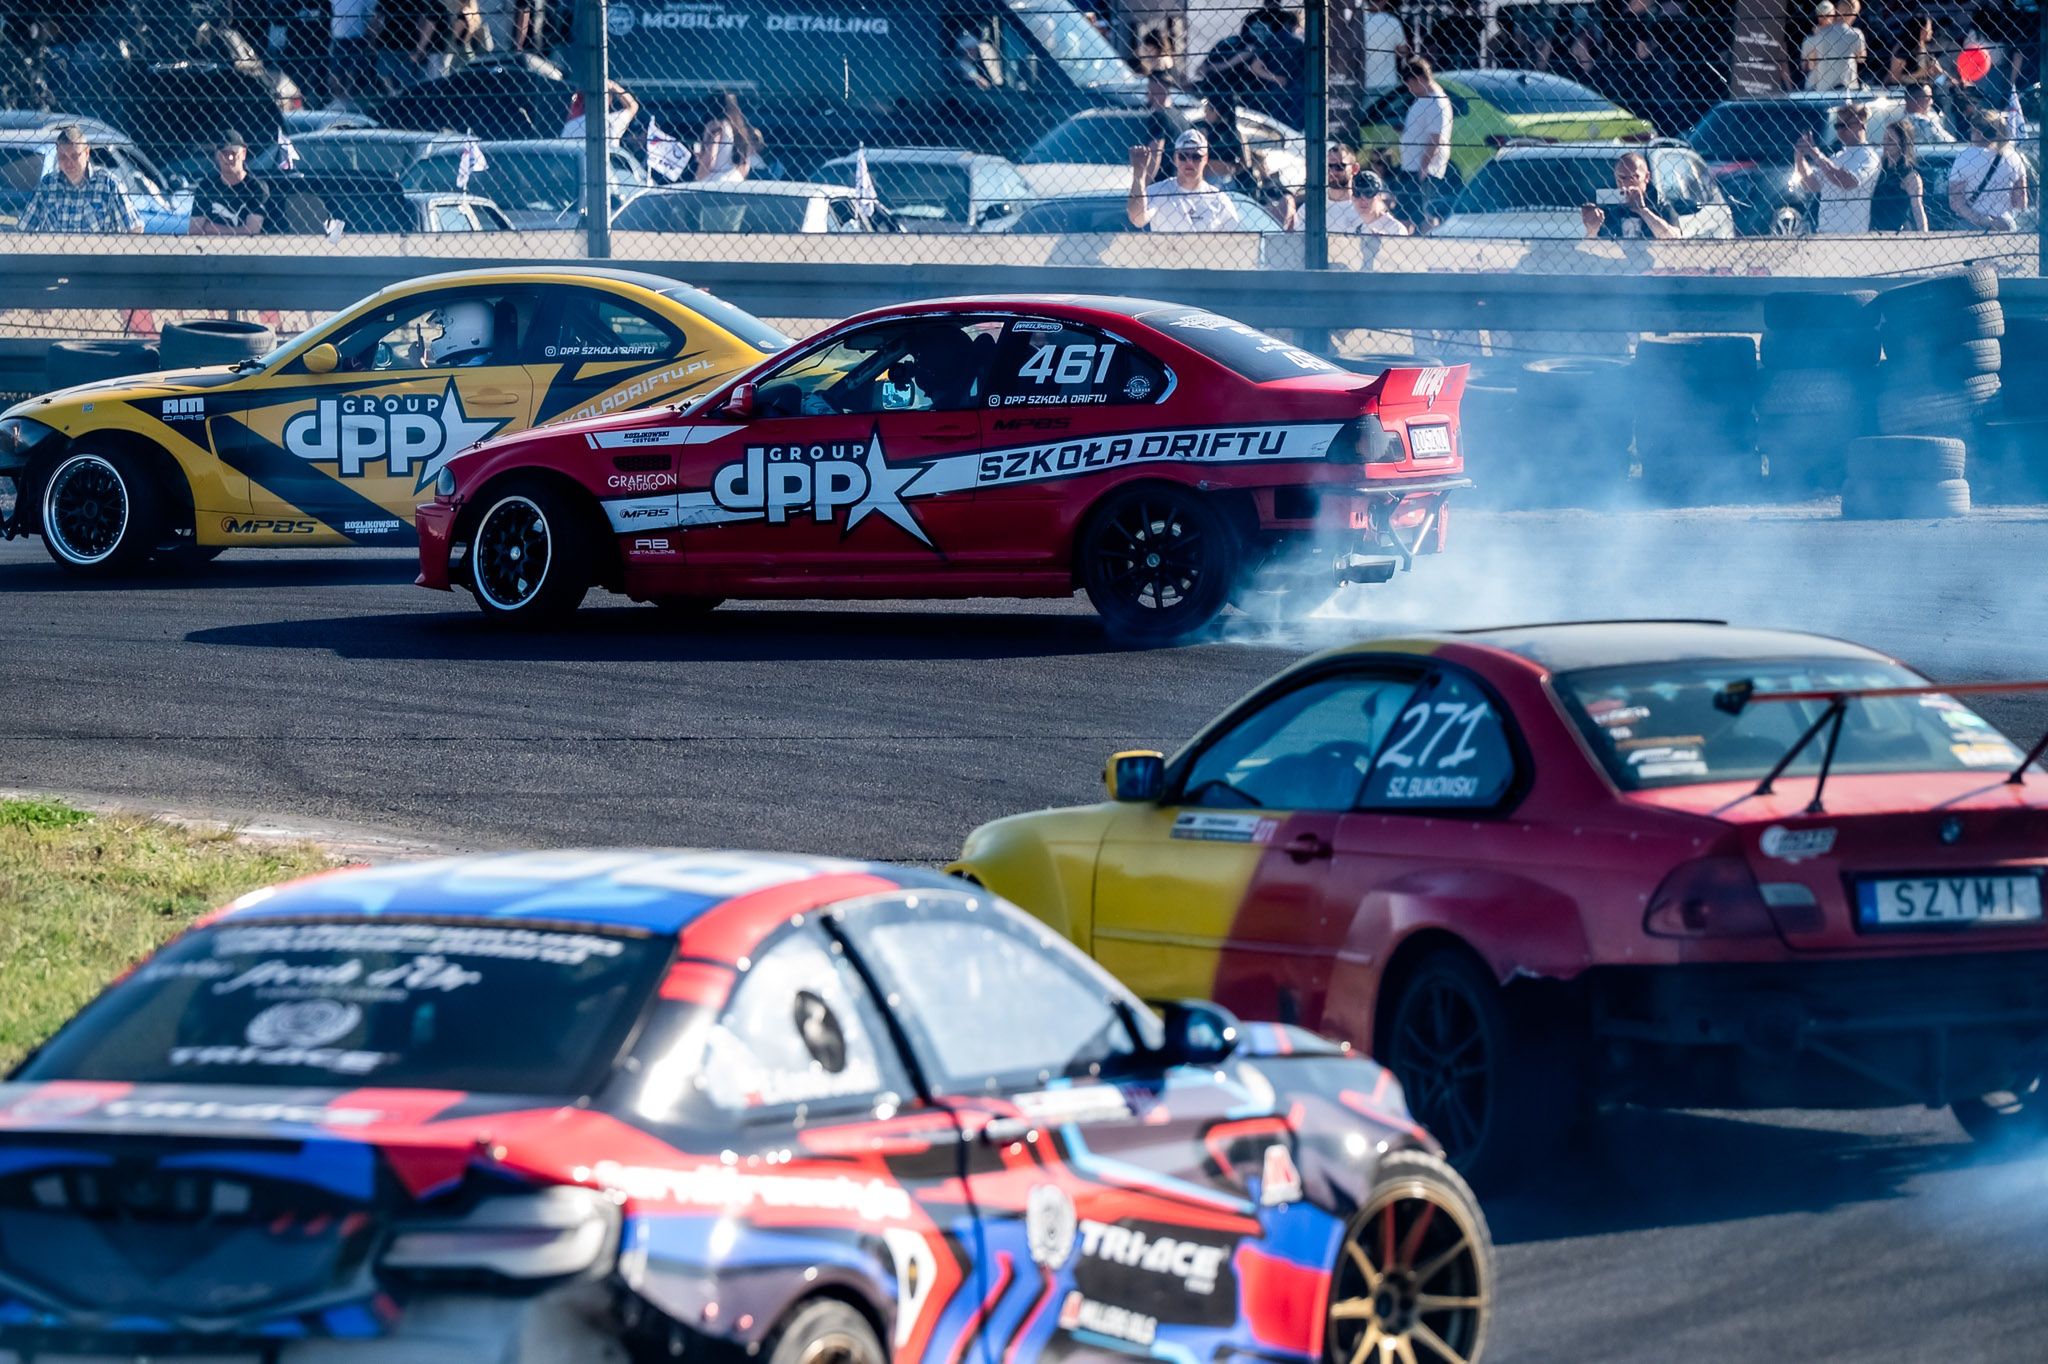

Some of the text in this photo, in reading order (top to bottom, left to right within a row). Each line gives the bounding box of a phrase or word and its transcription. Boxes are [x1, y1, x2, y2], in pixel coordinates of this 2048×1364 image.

[642, 12, 749, 30] MOBILNY
[767, 14, 889, 34] DETAILING
[560, 346, 656, 355] DPP SZKOŁA DRIFTU
[1018, 344, 1117, 385] 461
[162, 397, 204, 414] AM
[343, 398, 439, 413] GROUP
[1004, 394, 1108, 405] DPP SZKOŁA DRIFTU
[769, 445, 864, 461] GROUP
[979, 431, 1288, 482] SZKOŁA DRIFTU
[607, 474, 678, 488] GRAFICON
[627, 482, 658, 491] STUDIO
[344, 520, 400, 529] KOZLIKOWSKI
[635, 539, 669, 549] AB
[1377, 702, 1489, 769] 271
[1894, 878, 2015, 917] SZYMI
